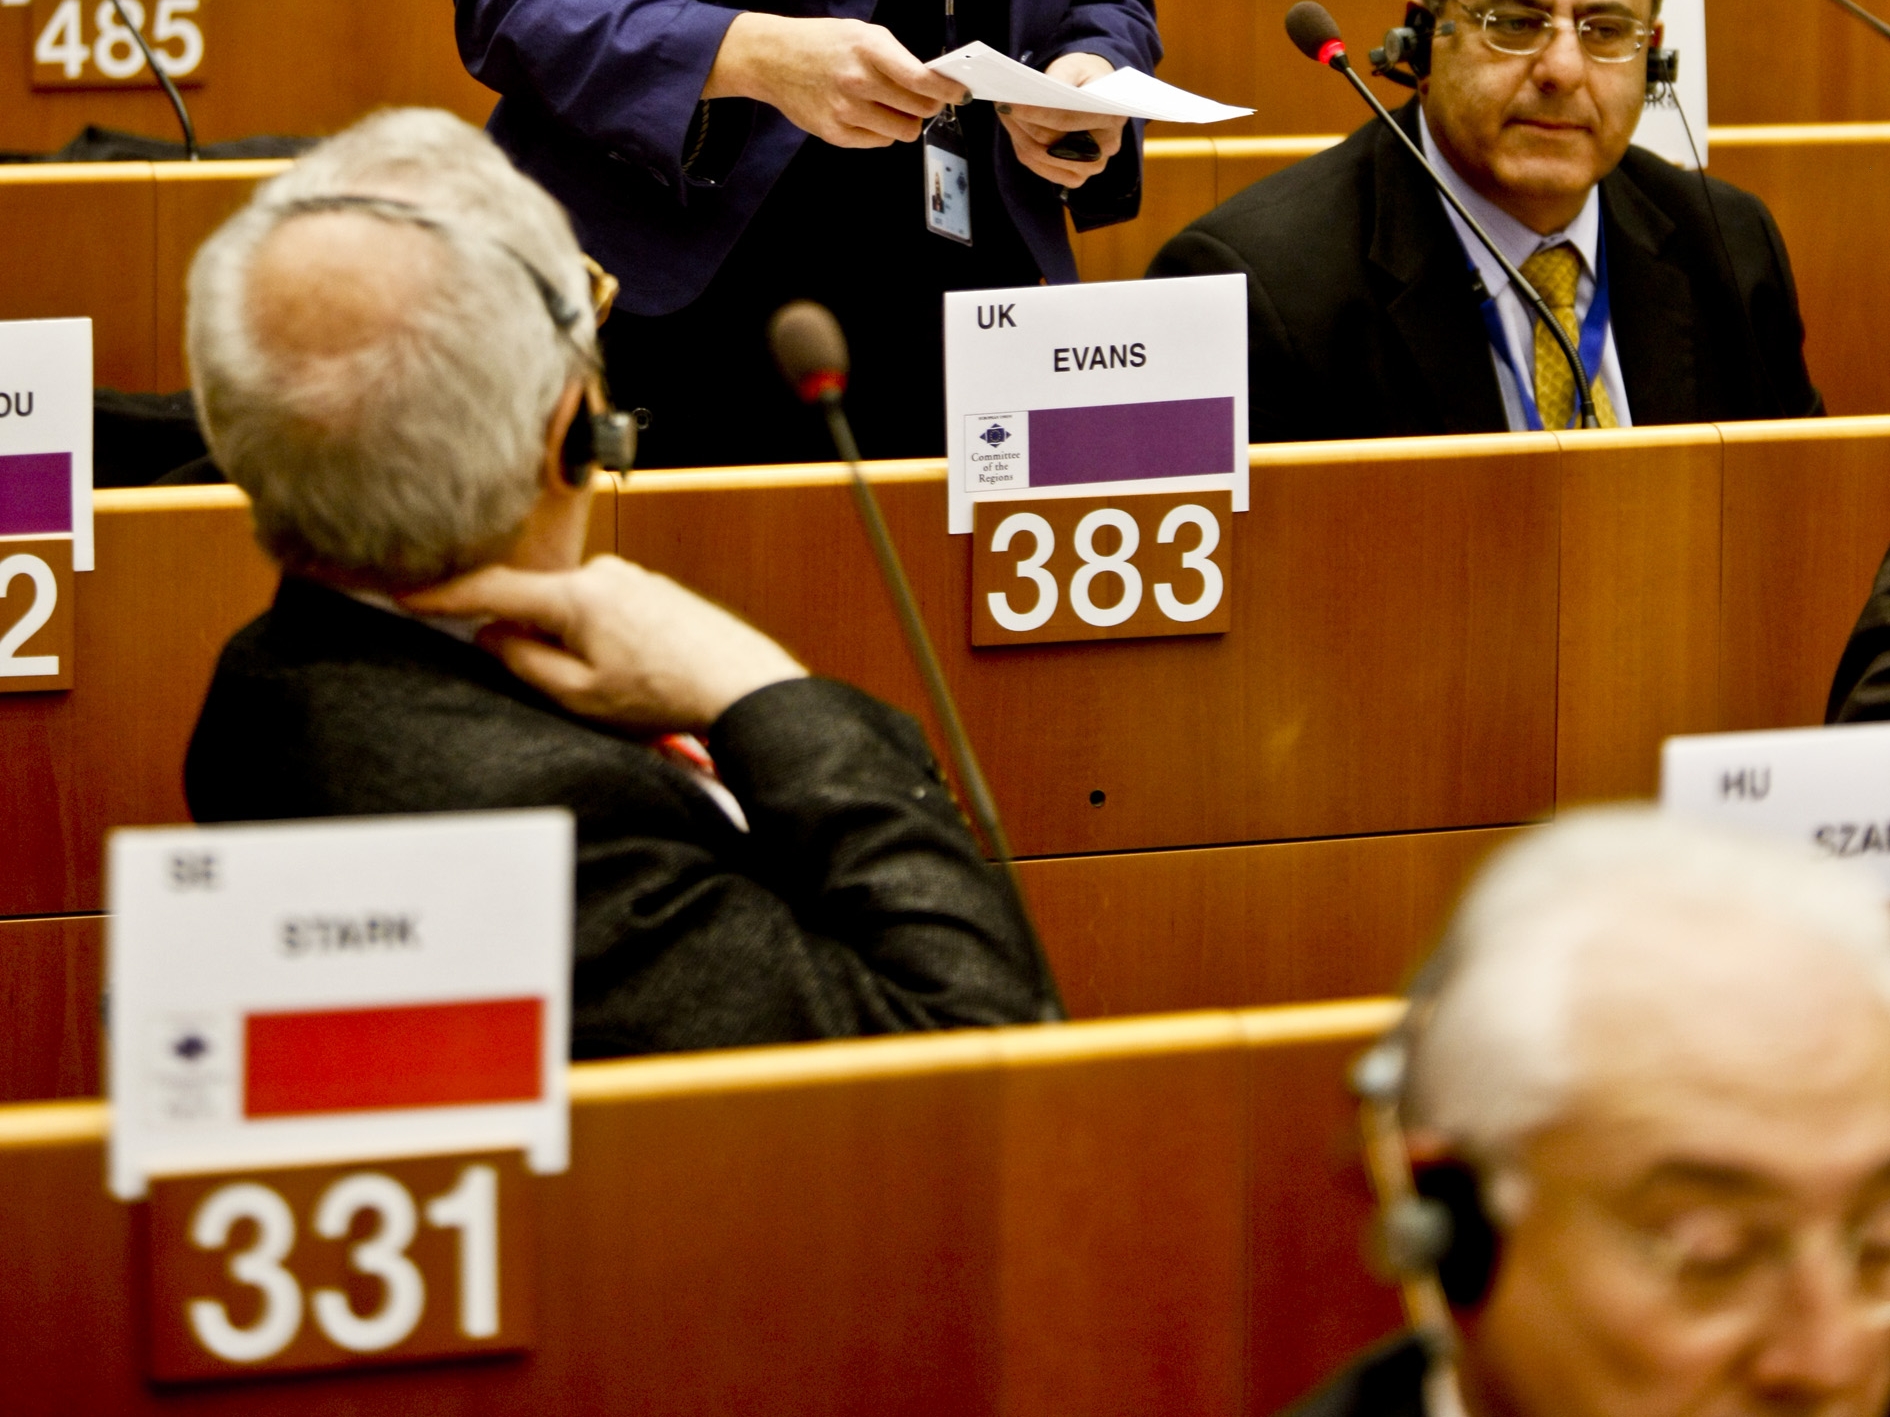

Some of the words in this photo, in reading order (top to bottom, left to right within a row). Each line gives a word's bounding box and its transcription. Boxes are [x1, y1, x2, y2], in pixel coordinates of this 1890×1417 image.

[976, 303, 1017, 330] UK
[1053, 342, 1147, 373] EVANS
[971, 451, 1021, 462] Committee
[983, 462, 993, 472] of
[995, 462, 1009, 471] the
[978, 473, 1014, 485] Regions
[987, 504, 1225, 632] 383
[1721, 766, 1772, 801] HU
[1815, 822, 1890, 858] SZA
[279, 912, 420, 958] STARK
[187, 1163, 501, 1363] 331
